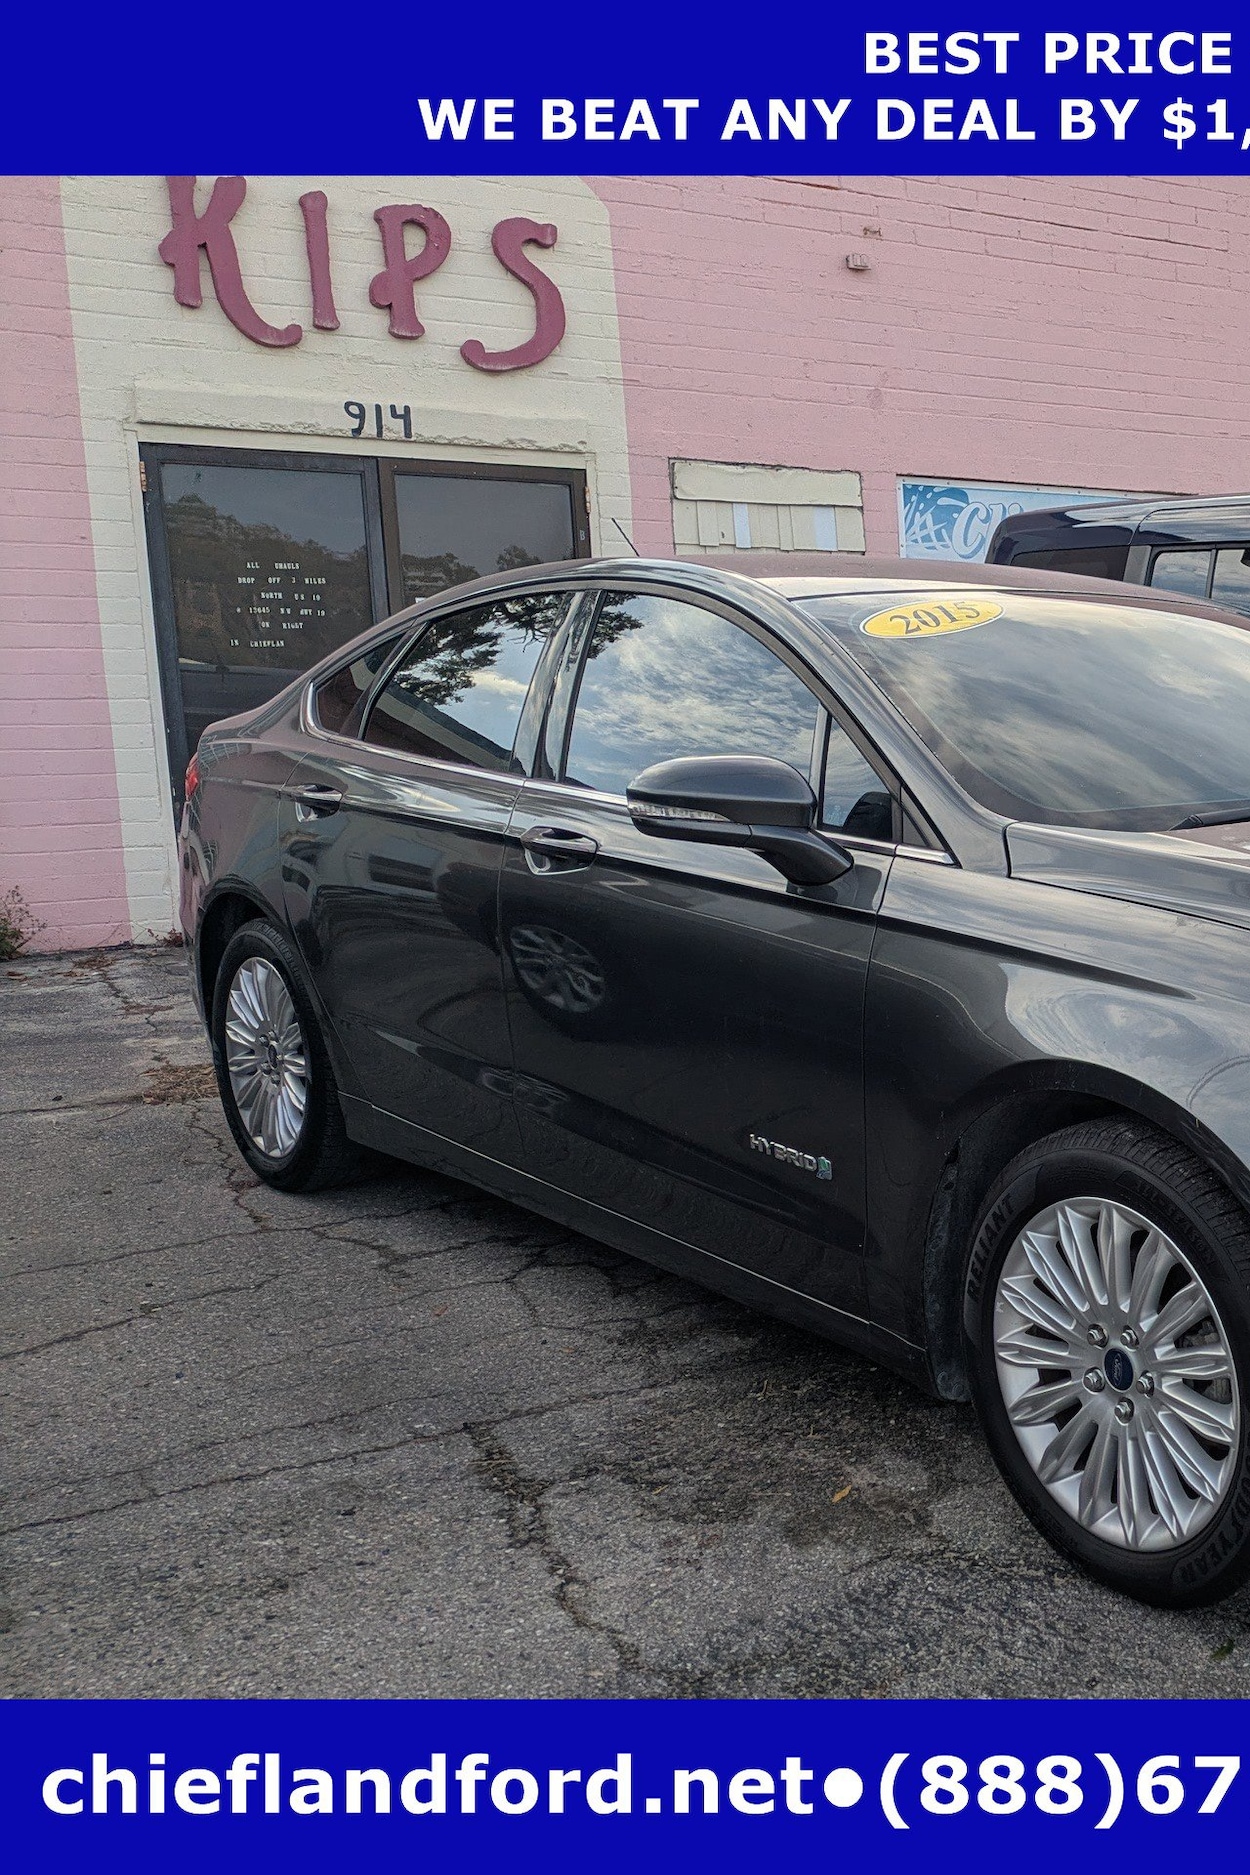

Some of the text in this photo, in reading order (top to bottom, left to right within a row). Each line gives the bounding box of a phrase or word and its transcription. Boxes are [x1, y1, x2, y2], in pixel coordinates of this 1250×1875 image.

[158, 176, 567, 373] KIPS
[344, 401, 413, 439] 914
[237, 576, 255, 584] DROP
[267, 576, 281, 584] OFF
[304, 577, 327, 585] MILES
[246, 561, 261, 570] ALL
[260, 591, 283, 600] NORTH
[890, 600, 980, 635] 2015
[749, 1133, 818, 1172] HYBRID
[966, 1193, 1015, 1303] RELIANT
